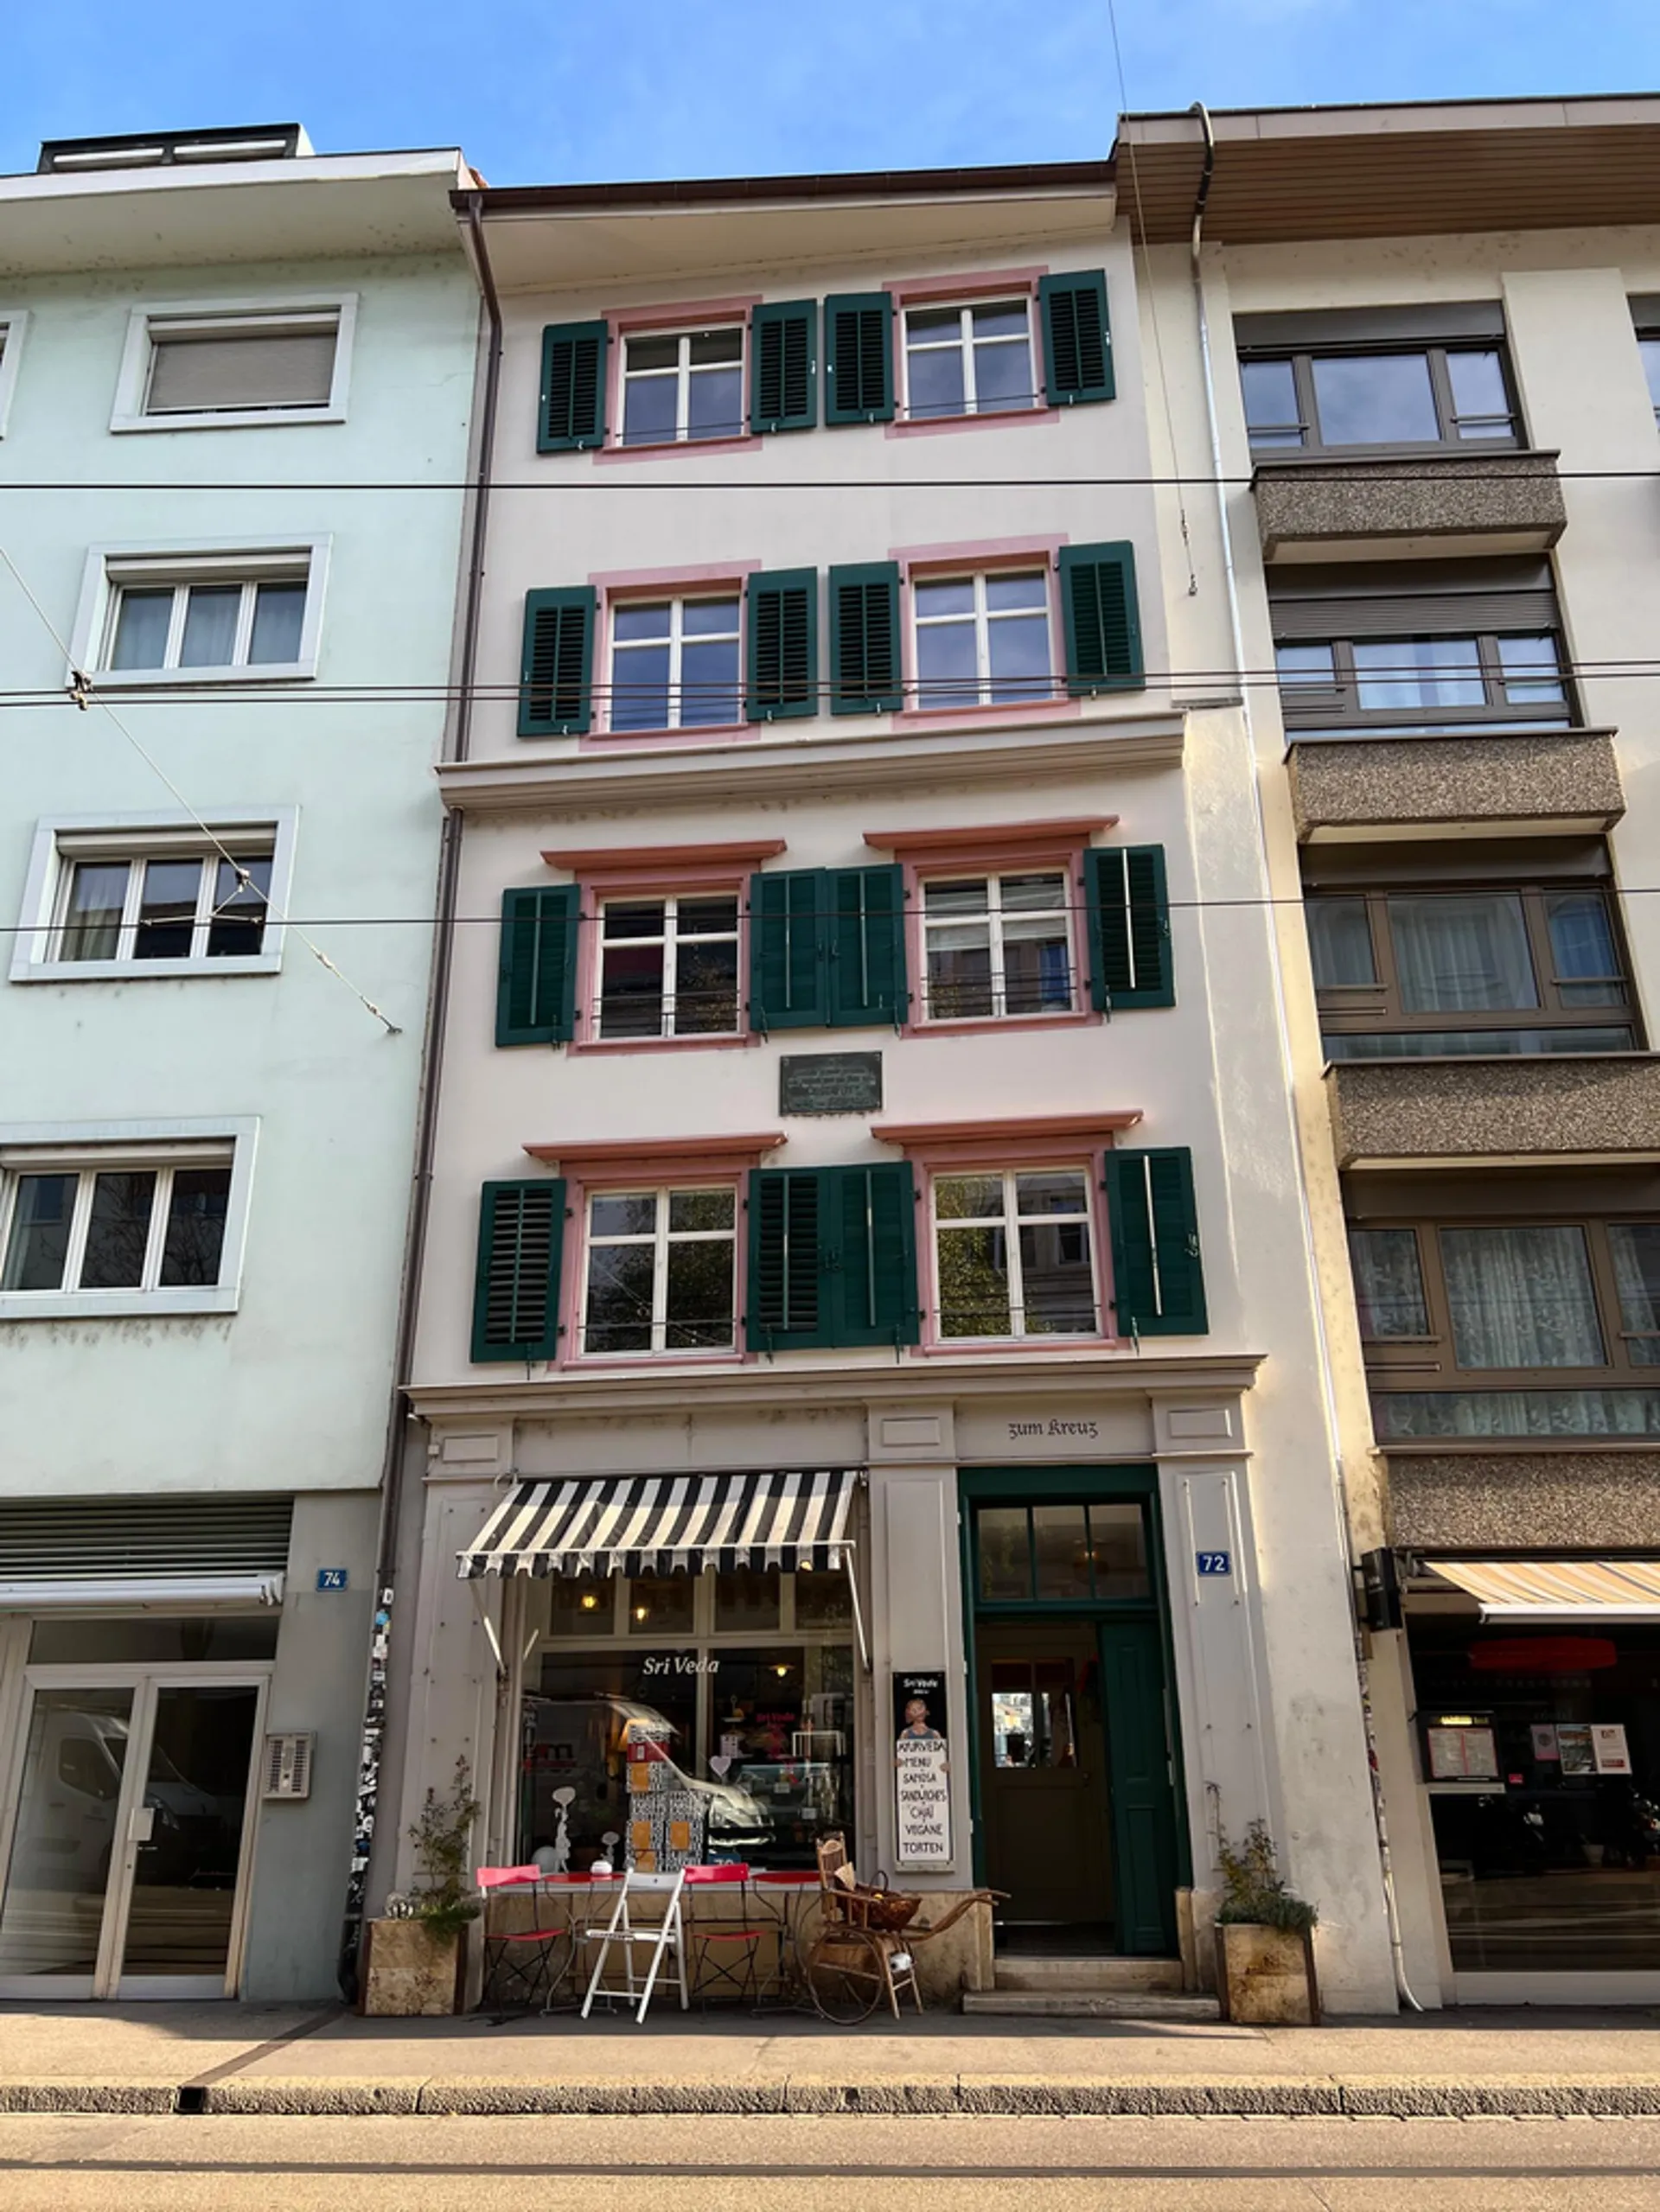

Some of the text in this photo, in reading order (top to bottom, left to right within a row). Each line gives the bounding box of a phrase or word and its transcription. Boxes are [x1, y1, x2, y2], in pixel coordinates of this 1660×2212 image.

[1008, 1418, 1099, 1439] zum Kreuz
[1203, 1555, 1225, 1571] 72
[324, 1572, 340, 1586] 74
[642, 1655, 720, 1675] Sri Veda
[903, 1773, 937, 1784] SAMOSA
[900, 1789, 947, 1802] SANDWICHES
[904, 1823, 943, 1836] VEGANE
[903, 1841, 943, 1854] TORTEN
